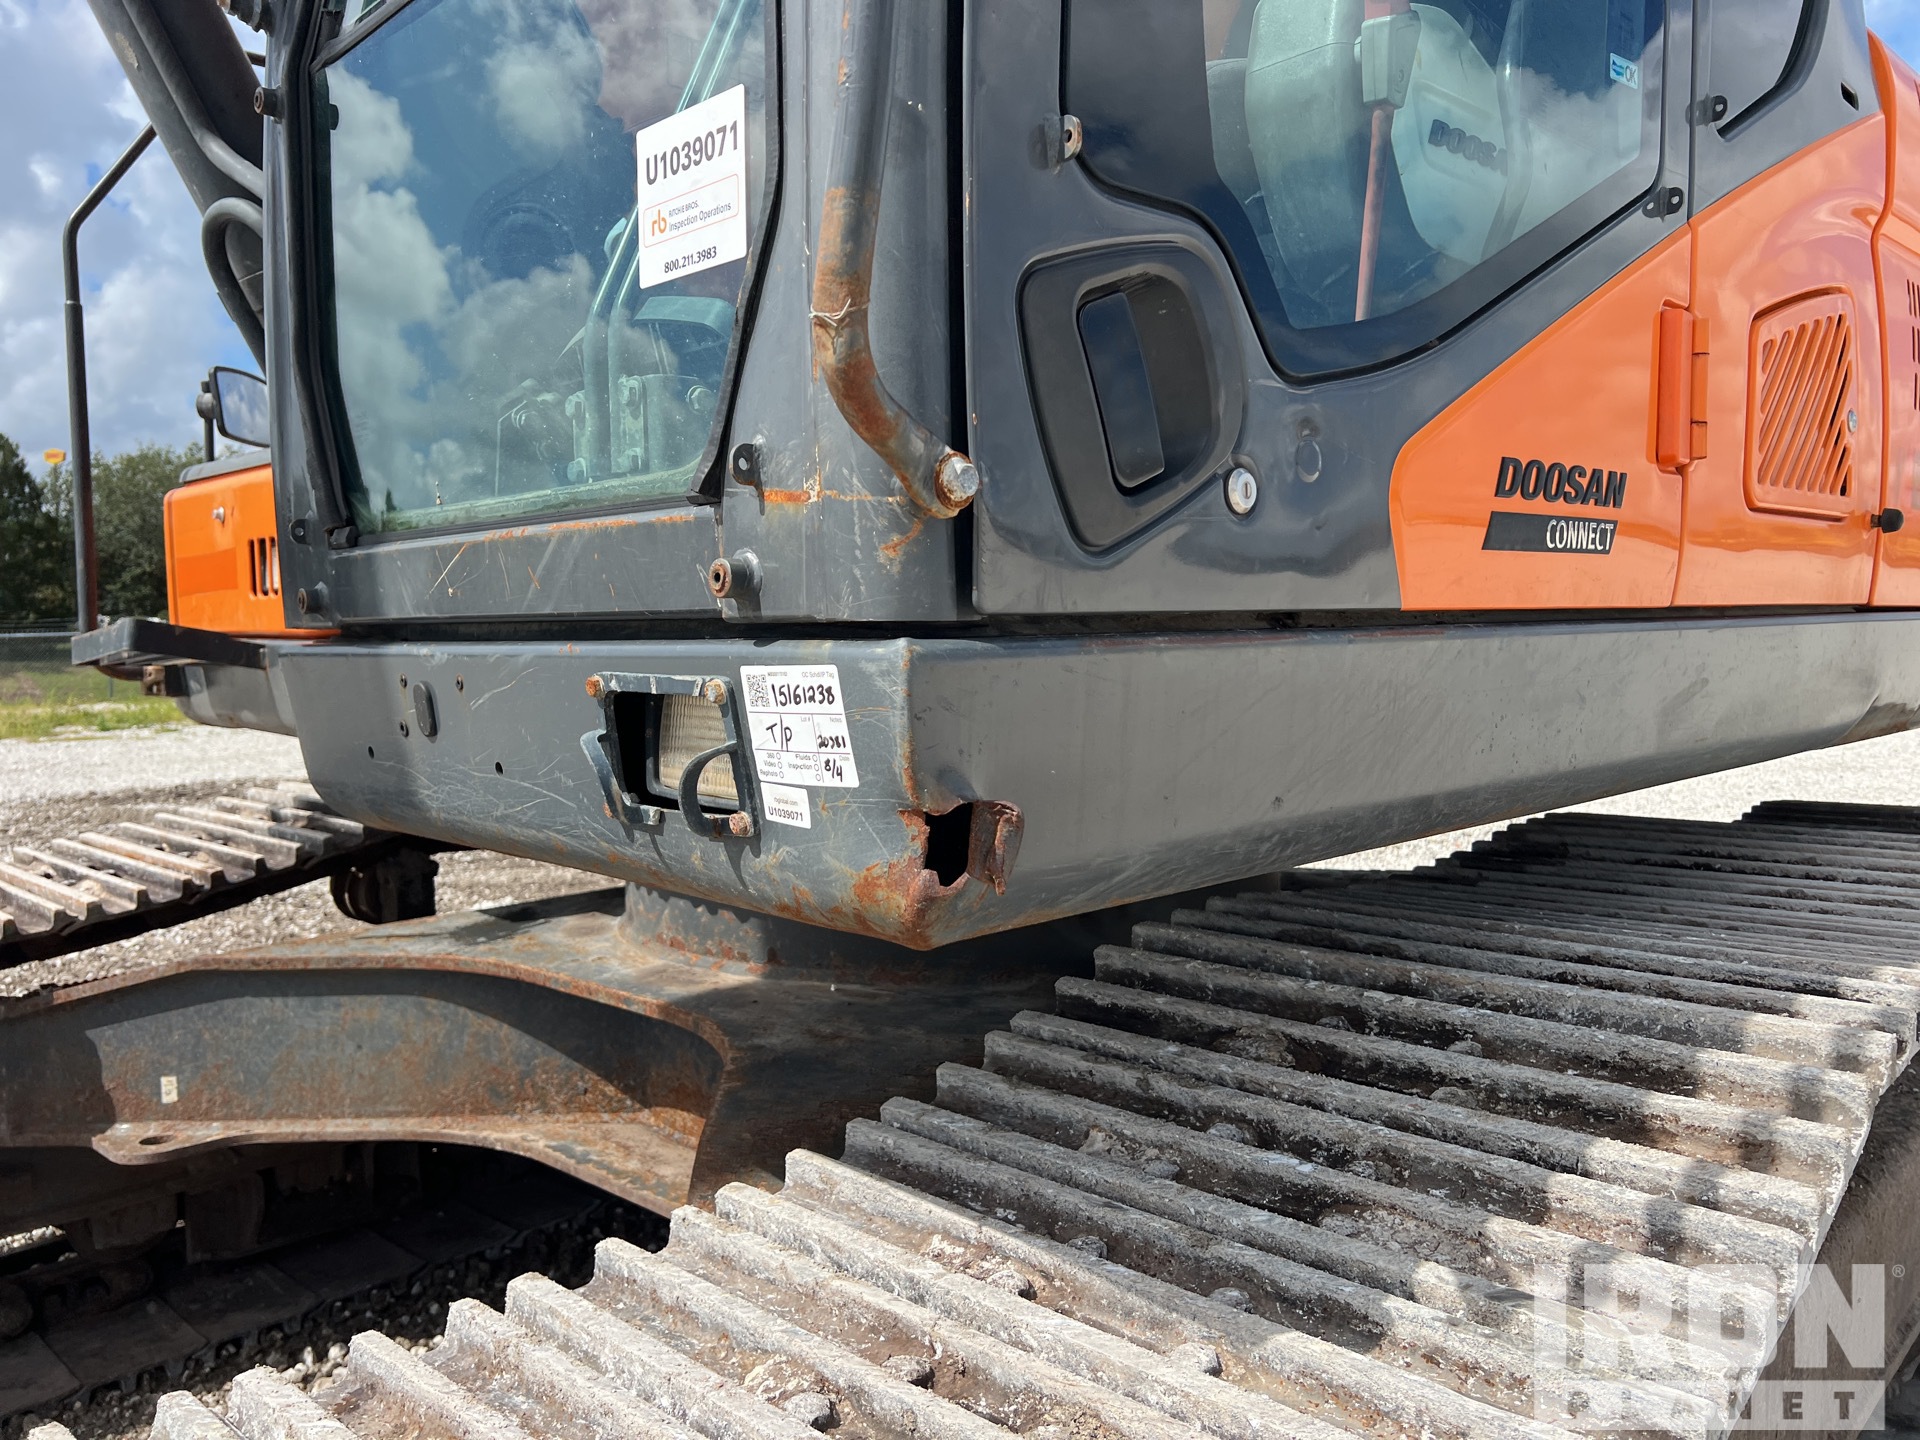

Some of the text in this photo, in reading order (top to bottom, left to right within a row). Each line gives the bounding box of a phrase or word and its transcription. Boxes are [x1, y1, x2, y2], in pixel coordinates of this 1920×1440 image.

[1625, 65, 1637, 85] OK
[646, 120, 738, 185] U1039071
[1428, 119, 1508, 176] DOOSA
[652, 209, 667, 236] rb
[668, 205, 685, 218] RITCHIE
[668, 202, 731, 232] Inspection Operations
[664, 246, 717, 273] 800.211.3983
[1494, 456, 1627, 509] DOOSAN
[1546, 519, 1614, 551] CONNECT
[826, 671, 835, 679] Tag
[771, 682, 835, 707] 15161238
[764, 760, 777, 768] Video
[824, 758, 843, 782] 8/4
[768, 806, 803, 821] U1039071
